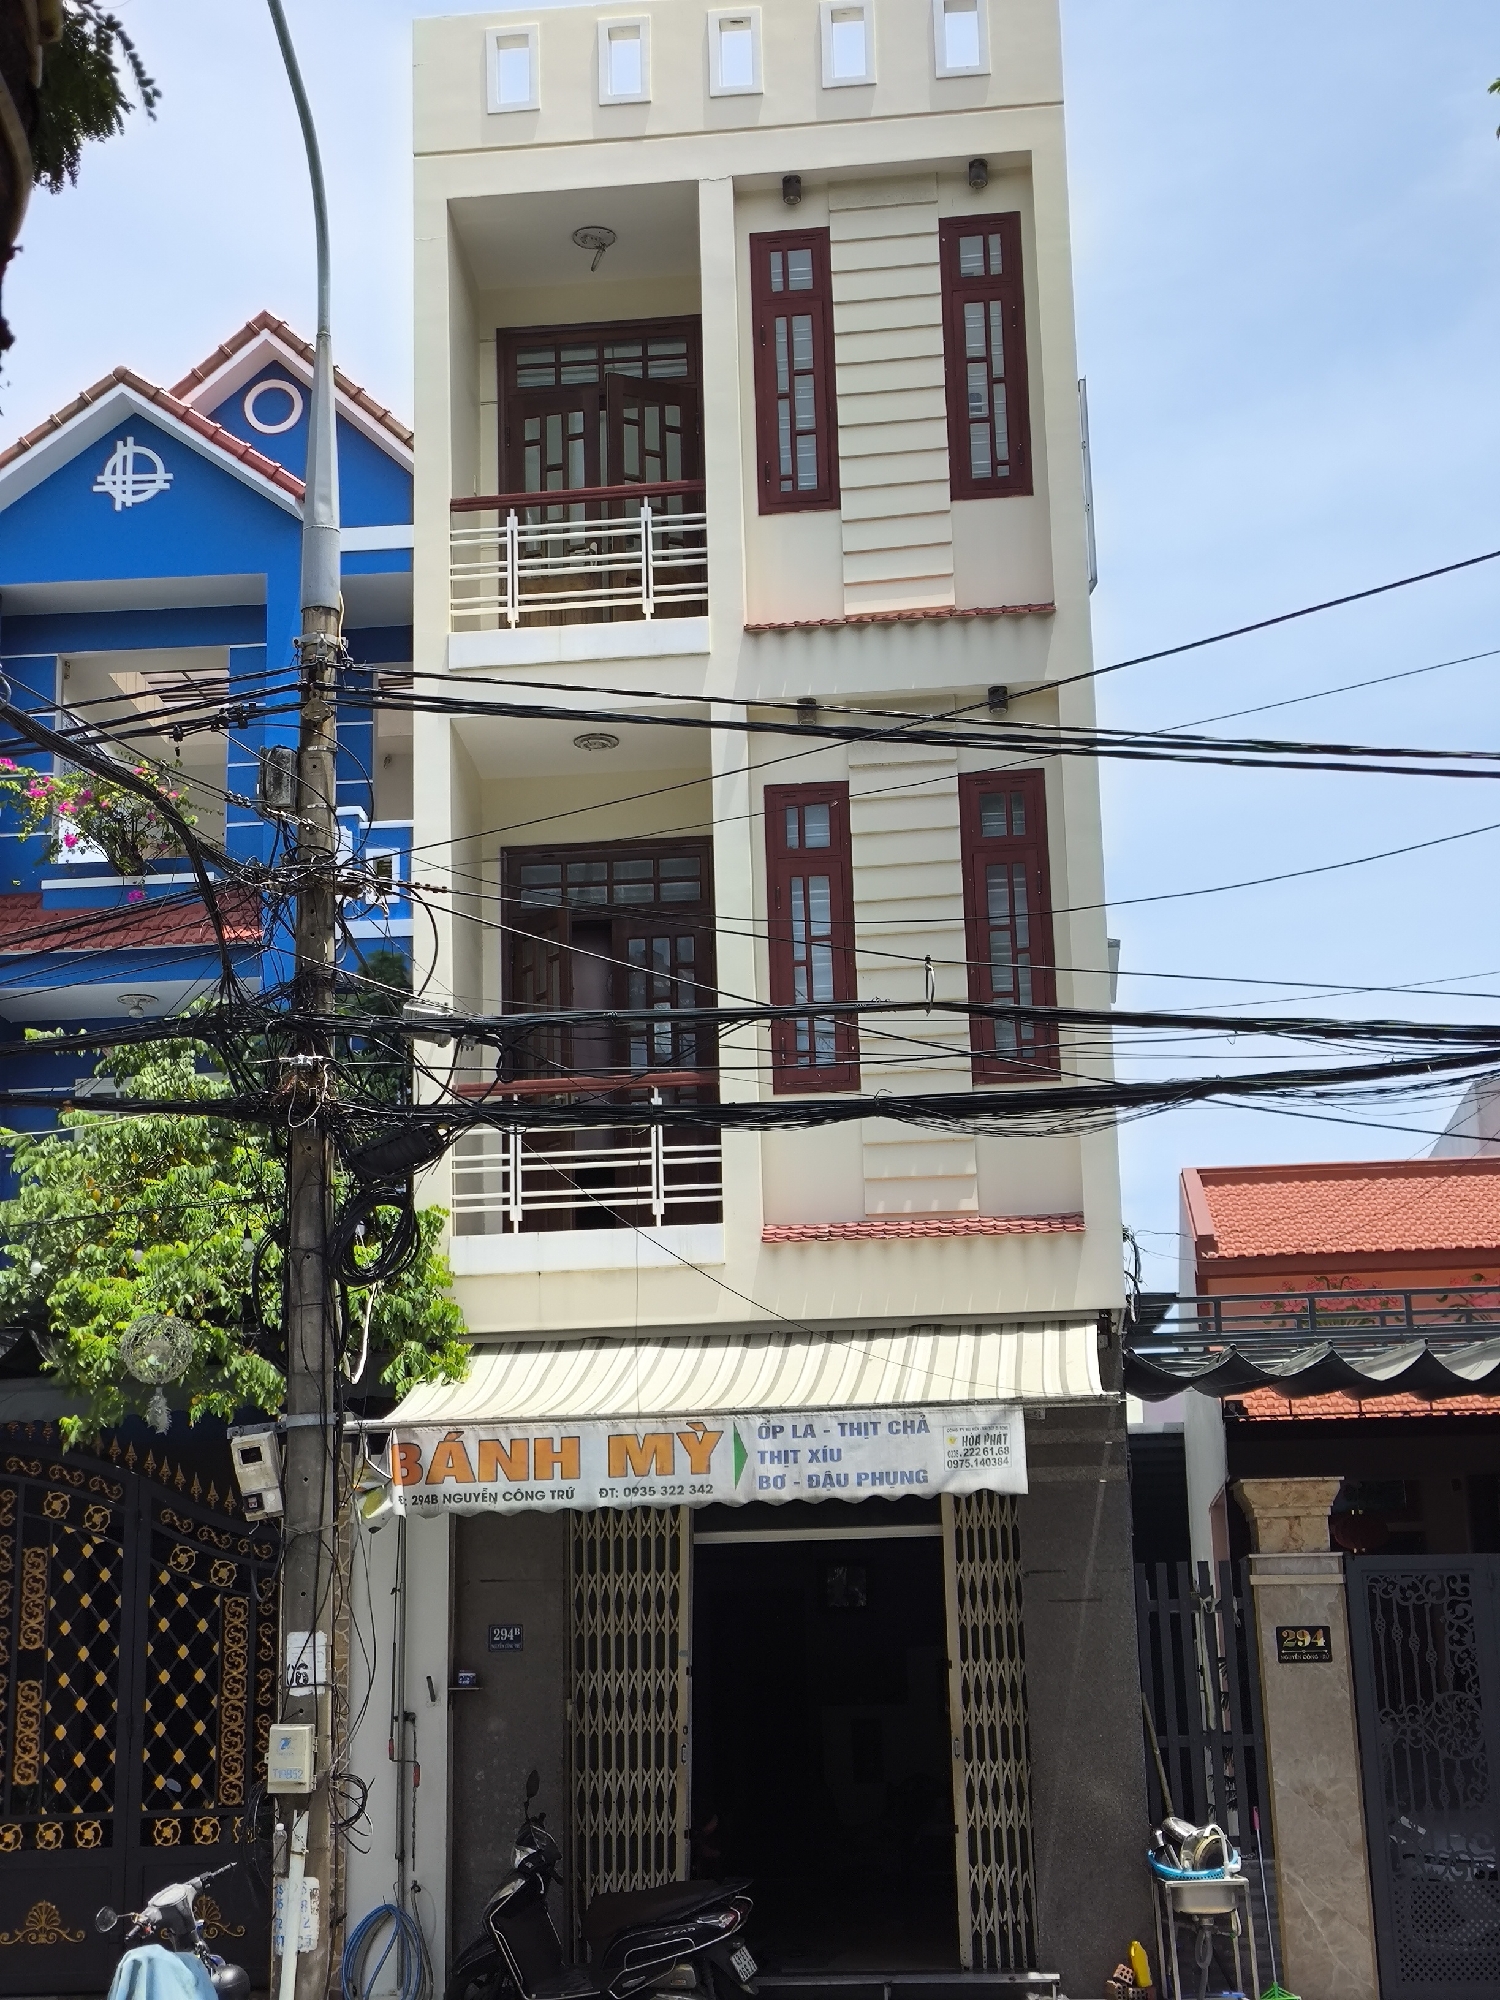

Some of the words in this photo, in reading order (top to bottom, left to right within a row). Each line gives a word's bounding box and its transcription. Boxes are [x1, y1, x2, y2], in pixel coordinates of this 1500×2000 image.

[757, 1419, 785, 1440] ỐP
[792, 1423, 816, 1439] LA
[838, 1421, 881, 1440] THỊT
[887, 1414, 930, 1435] CHẢ
[391, 1431, 581, 1487] BÁNH
[608, 1421, 724, 1478] MỲ
[757, 1450, 800, 1468] THỊT
[808, 1445, 842, 1464] XÍU
[598, 1487, 619, 1499] ĐT:
[623, 1486, 657, 1498] 0935
[660, 1484, 685, 1496] 322
[688, 1483, 714, 1496] 342
[758, 1473, 787, 1490] BƠ
[808, 1470, 849, 1492] ĐẬU
[856, 1468, 929, 1489] PHỤNG
[411, 1493, 439, 1506] 294B
[442, 1487, 498, 1504] NGUYỄN
[502, 1488, 546, 1502] CÔNG
[550, 1486, 576, 1500] TRỨ
[1281, 1628, 1326, 1647] 294
